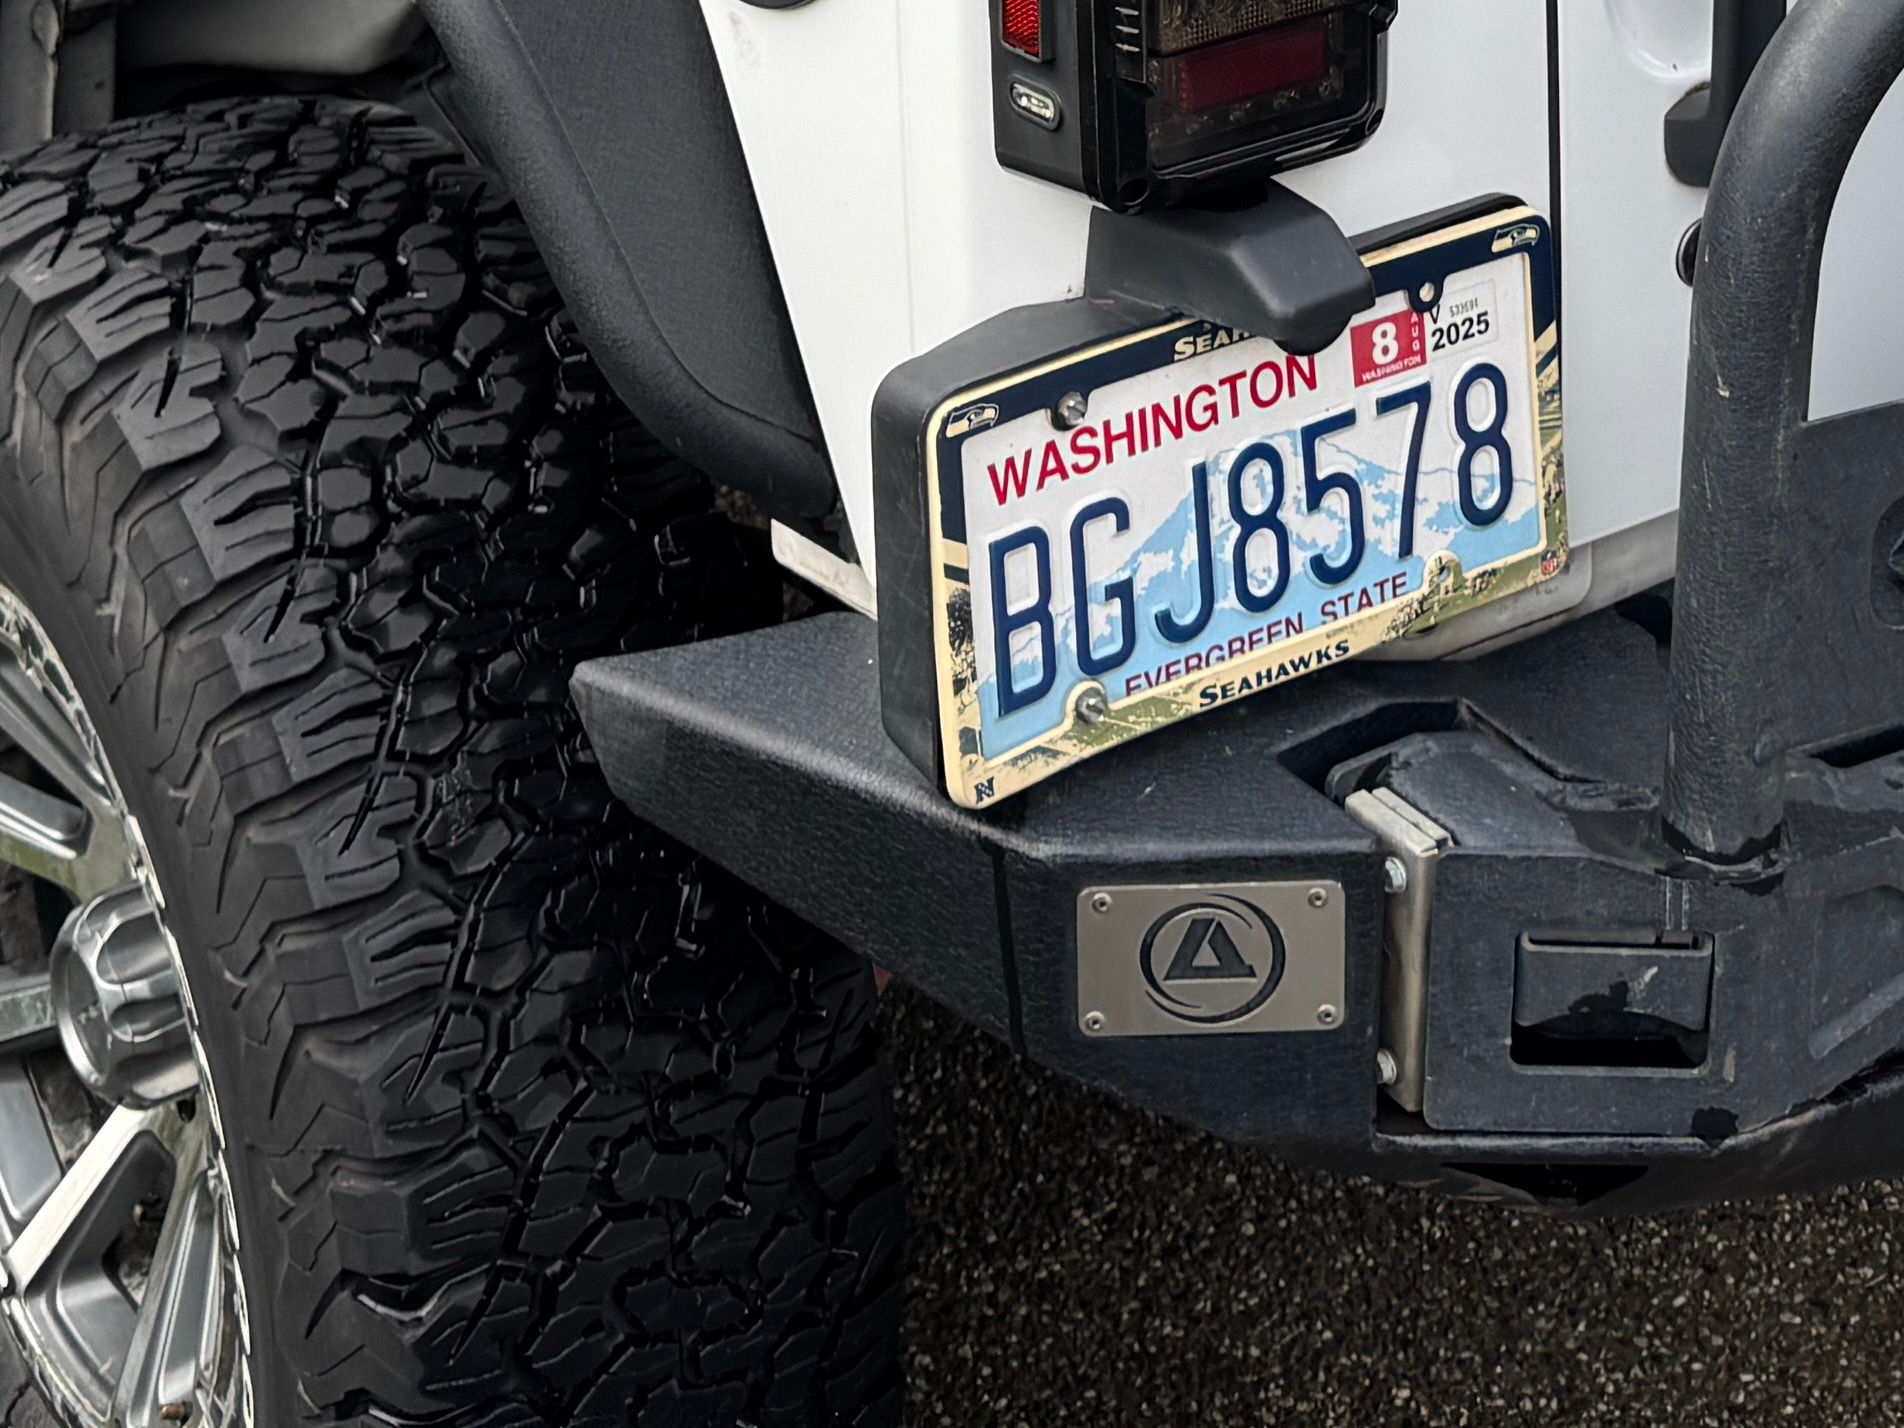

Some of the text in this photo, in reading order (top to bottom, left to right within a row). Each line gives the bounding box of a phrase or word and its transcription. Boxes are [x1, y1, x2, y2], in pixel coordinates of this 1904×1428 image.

[1371, 321, 1400, 365] 8
[1431, 310, 1490, 352] 2025
[988, 353, 1318, 506] WASHINGTON
[989, 362, 1514, 718] BGJ8578
[1124, 572, 1409, 697] EVERGREEN STATE
[1198, 639, 1351, 707] SEAHAWKS
